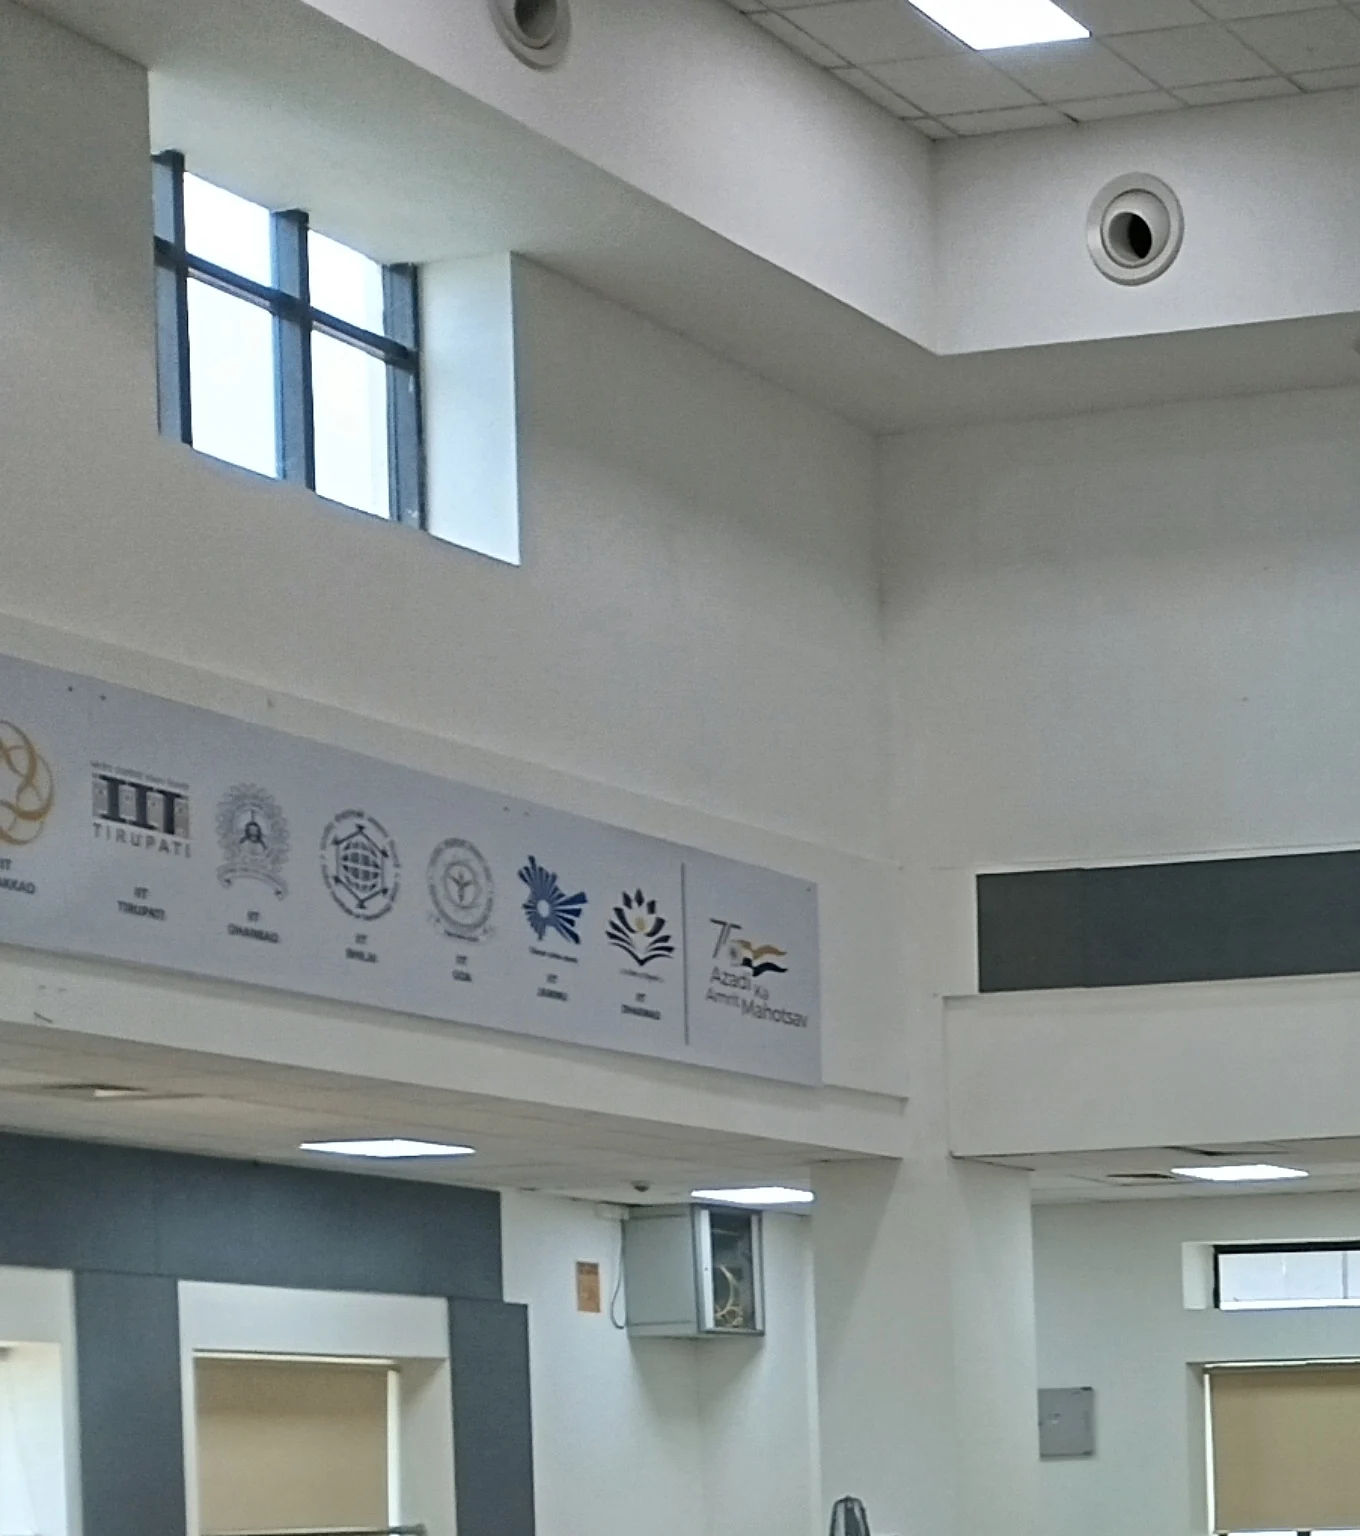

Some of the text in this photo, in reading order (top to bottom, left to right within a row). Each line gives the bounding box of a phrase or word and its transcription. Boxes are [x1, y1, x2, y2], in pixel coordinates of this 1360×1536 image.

[93, 822, 192, 859] TIRUPATI
[0, 876, 36, 895] AKKAD
[710, 966, 752, 991] Azadi
[705, 987, 809, 1028] Amrit Mahotsav
